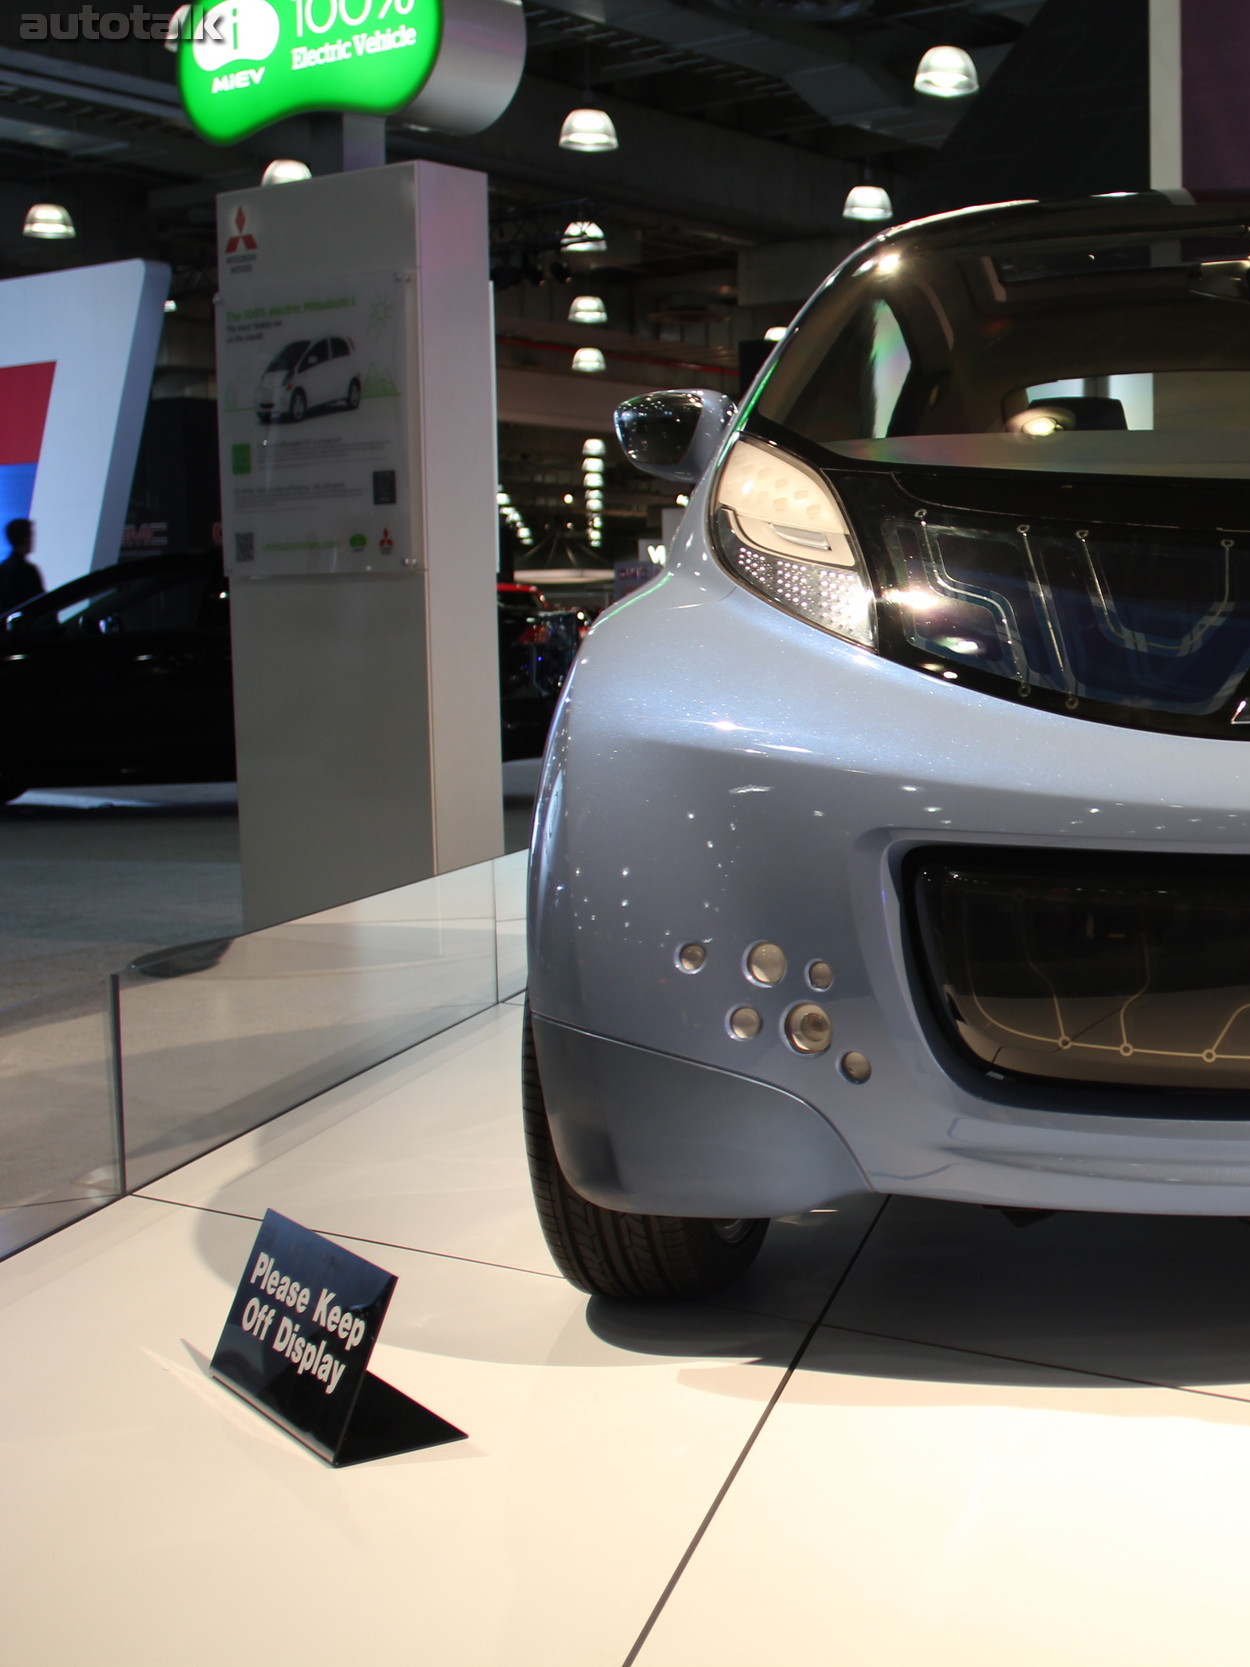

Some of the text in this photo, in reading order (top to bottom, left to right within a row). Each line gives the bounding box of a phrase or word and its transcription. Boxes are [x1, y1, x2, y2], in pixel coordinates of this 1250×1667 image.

[291, 24, 417, 70] Electric Vehicle
[212, 66, 265, 94] MiEV
[122, 522, 168, 547] MC
[250, 1251, 366, 1351] Please Keep
[241, 1297, 346, 1395] Off Display
